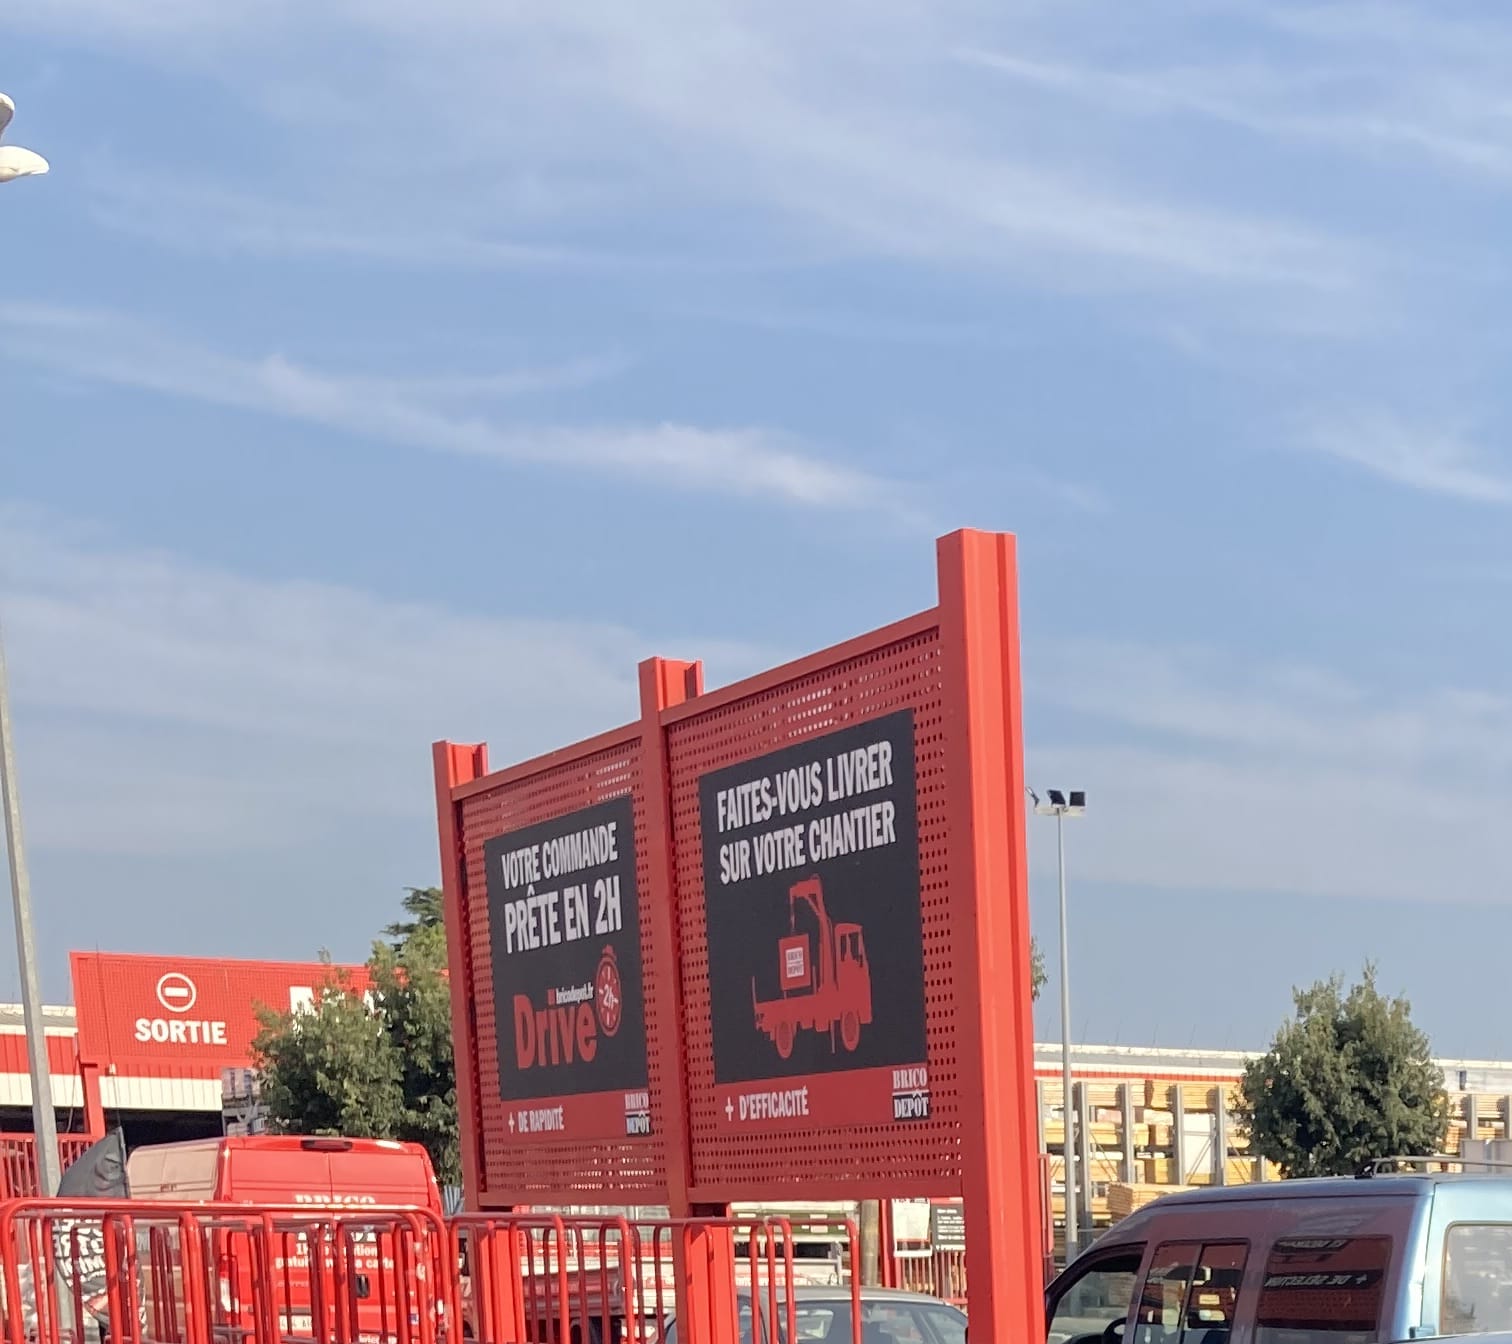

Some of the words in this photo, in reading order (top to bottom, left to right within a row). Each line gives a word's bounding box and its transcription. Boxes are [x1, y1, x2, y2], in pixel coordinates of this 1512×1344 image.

[717, 761, 823, 833] FAITES-VOUS
[827, 740, 893, 802] LIVRER
[501, 844, 541, 890] VOTRE
[542, 821, 618, 879] COMMANDE
[719, 839, 752, 885] SUR
[753, 823, 806, 876] VOTRE
[808, 800, 896, 863] CHANTIER
[504, 884, 561, 954] PRÊTE
[563, 883, 590, 941] EN
[594, 875, 622, 935] 2H
[134, 1018, 227, 1045] SORTIE
[513, 990, 597, 1070] Drive
[892, 1067, 928, 1089] BRICO
[518, 1111, 529, 1132] DE
[529, 1105, 565, 1132] RAPIDITÉ
[625, 1093, 649, 1110] BRICO
[739, 1086, 809, 1121] D'EFFICACITÉ
[893, 1089, 930, 1118] DEPÔT
